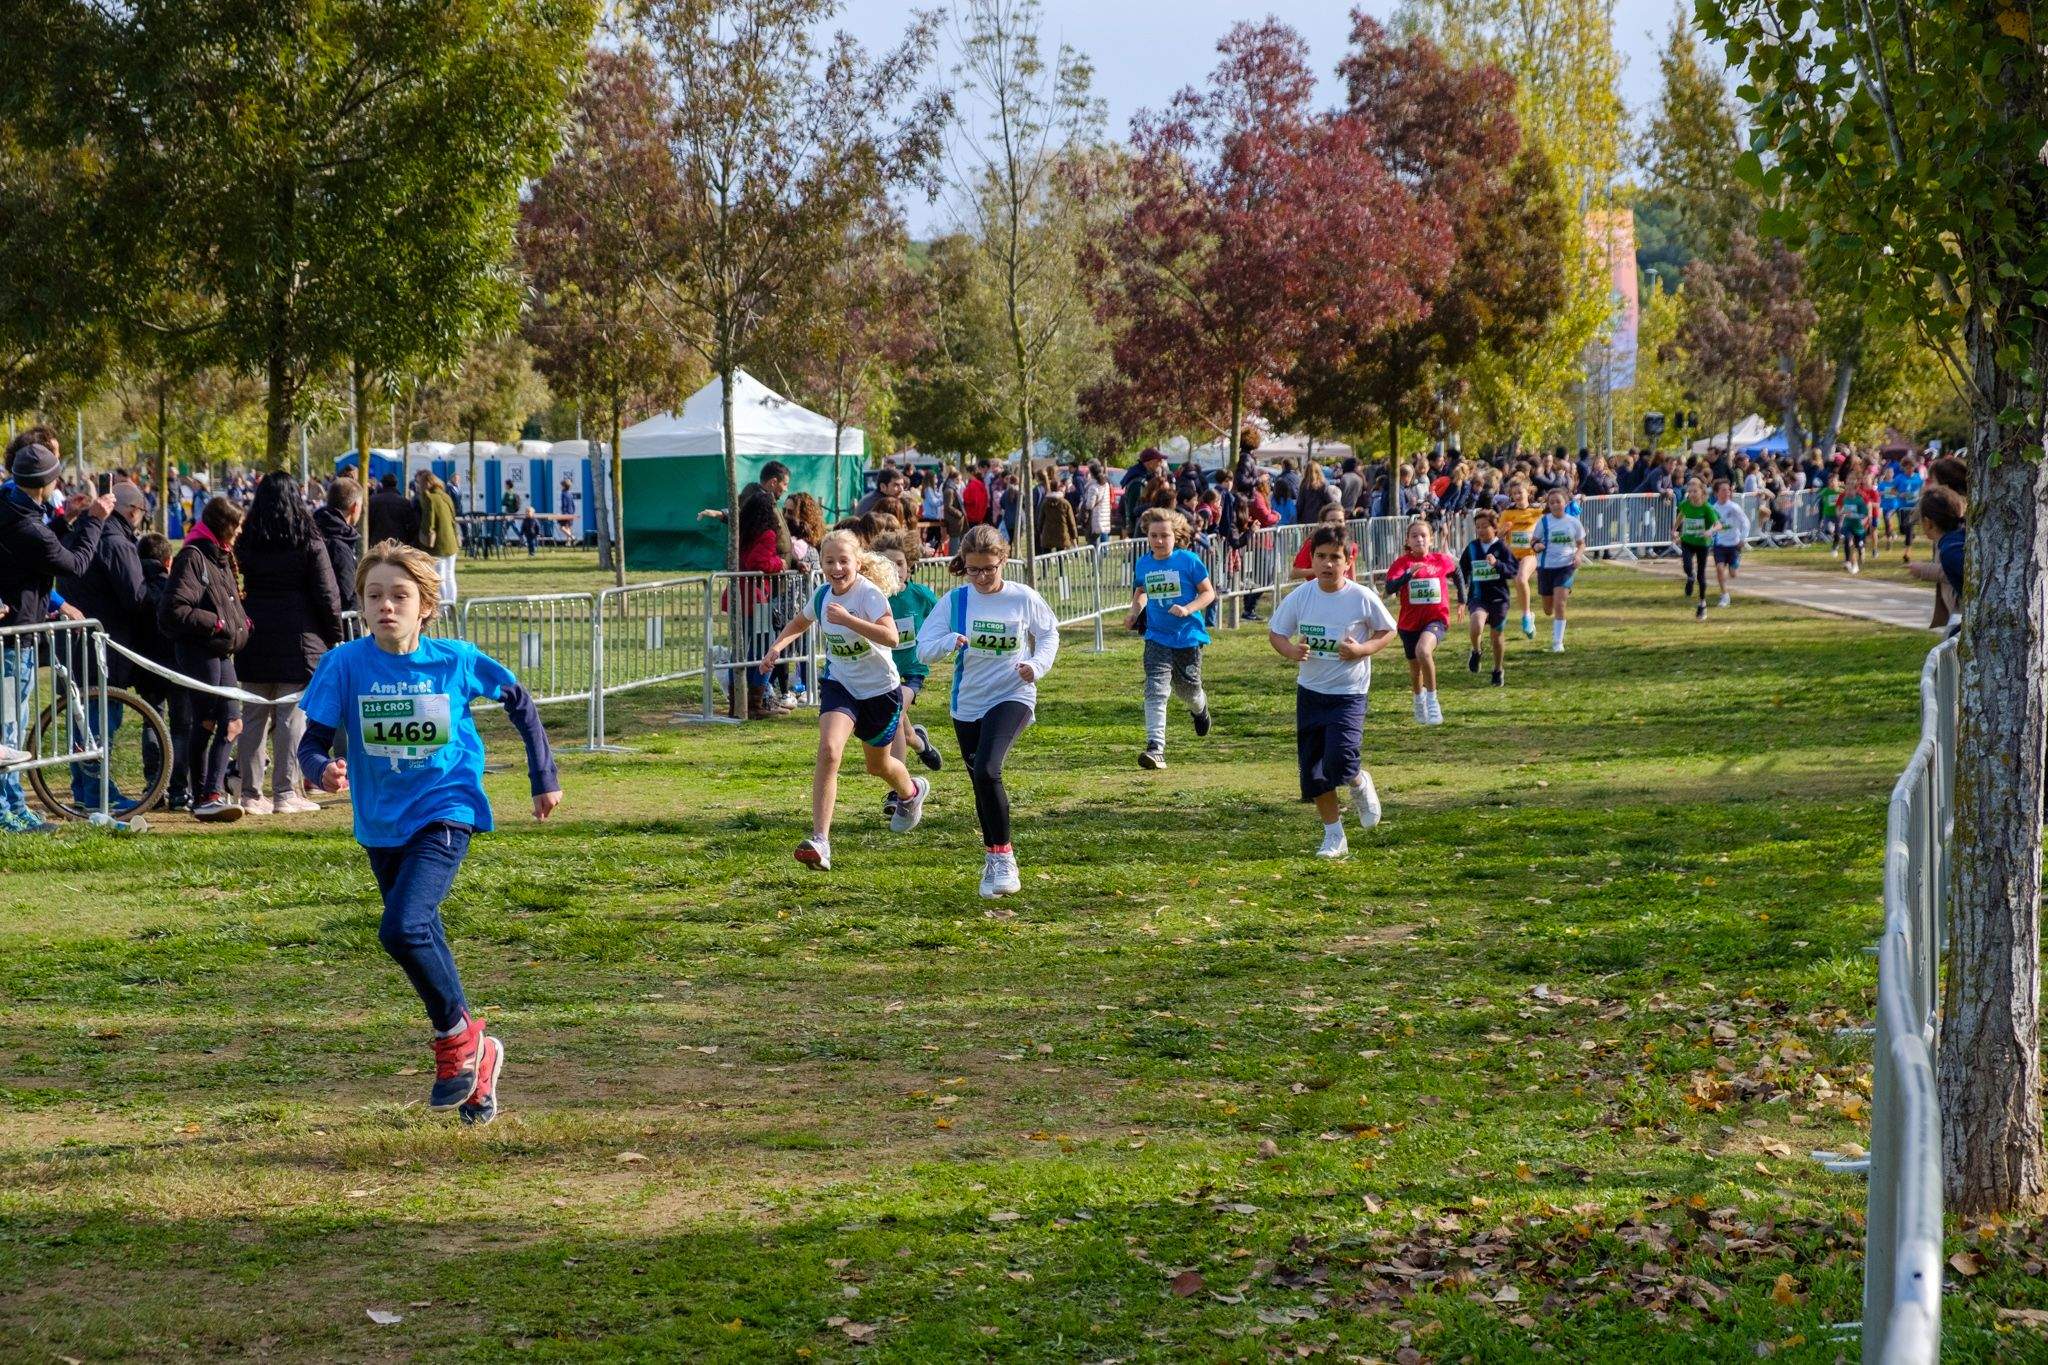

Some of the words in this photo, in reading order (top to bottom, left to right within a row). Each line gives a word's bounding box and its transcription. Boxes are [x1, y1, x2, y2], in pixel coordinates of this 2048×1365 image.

[1151, 582, 1175, 592] 1473
[986, 622, 1004, 630] CROS
[976, 634, 1017, 648] 4213
[364, 703, 381, 711] 21è
[384, 702, 411, 711] CROS
[373, 721, 437, 742] 1469
